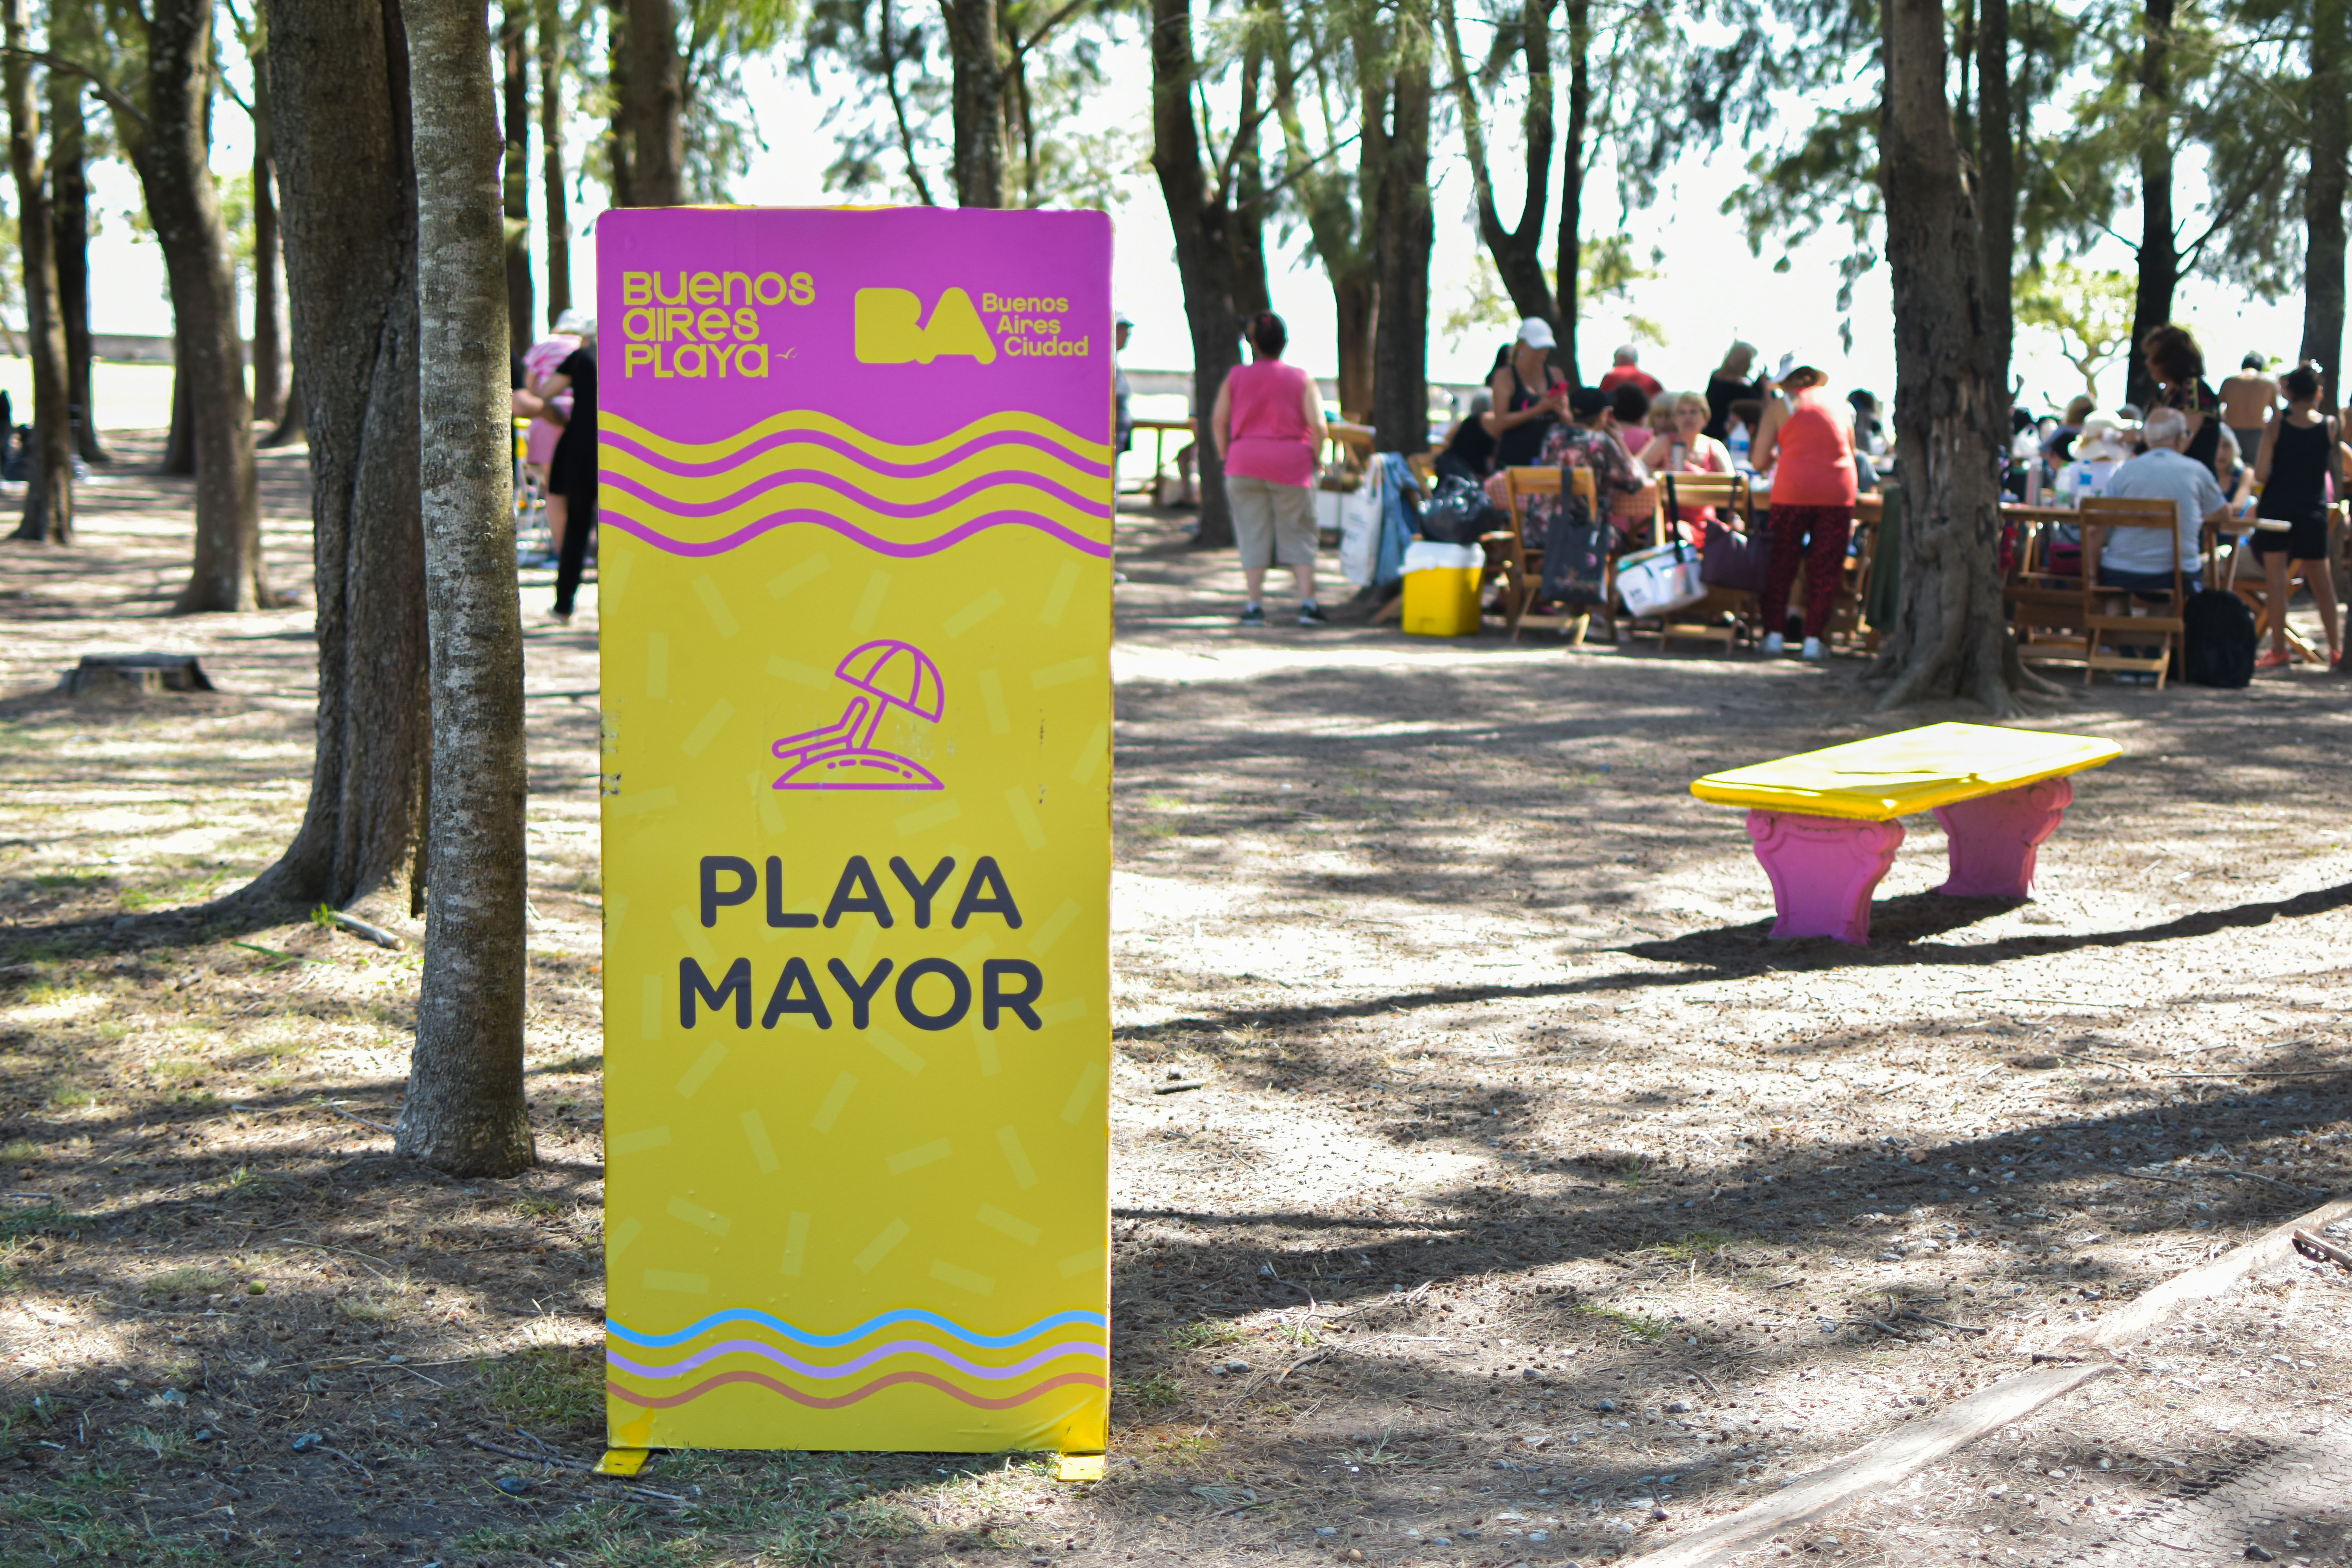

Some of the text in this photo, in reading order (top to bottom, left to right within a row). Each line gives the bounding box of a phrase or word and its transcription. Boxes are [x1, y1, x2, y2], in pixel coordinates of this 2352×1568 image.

[855, 287, 997, 364] BA
[983, 293, 1069, 312] Buenos
[997, 315, 1061, 334] Aires
[1005, 336, 1089, 356] Ciudad
[700, 855, 1023, 929] PLAYA
[679, 957, 1043, 1031] MAYOR
